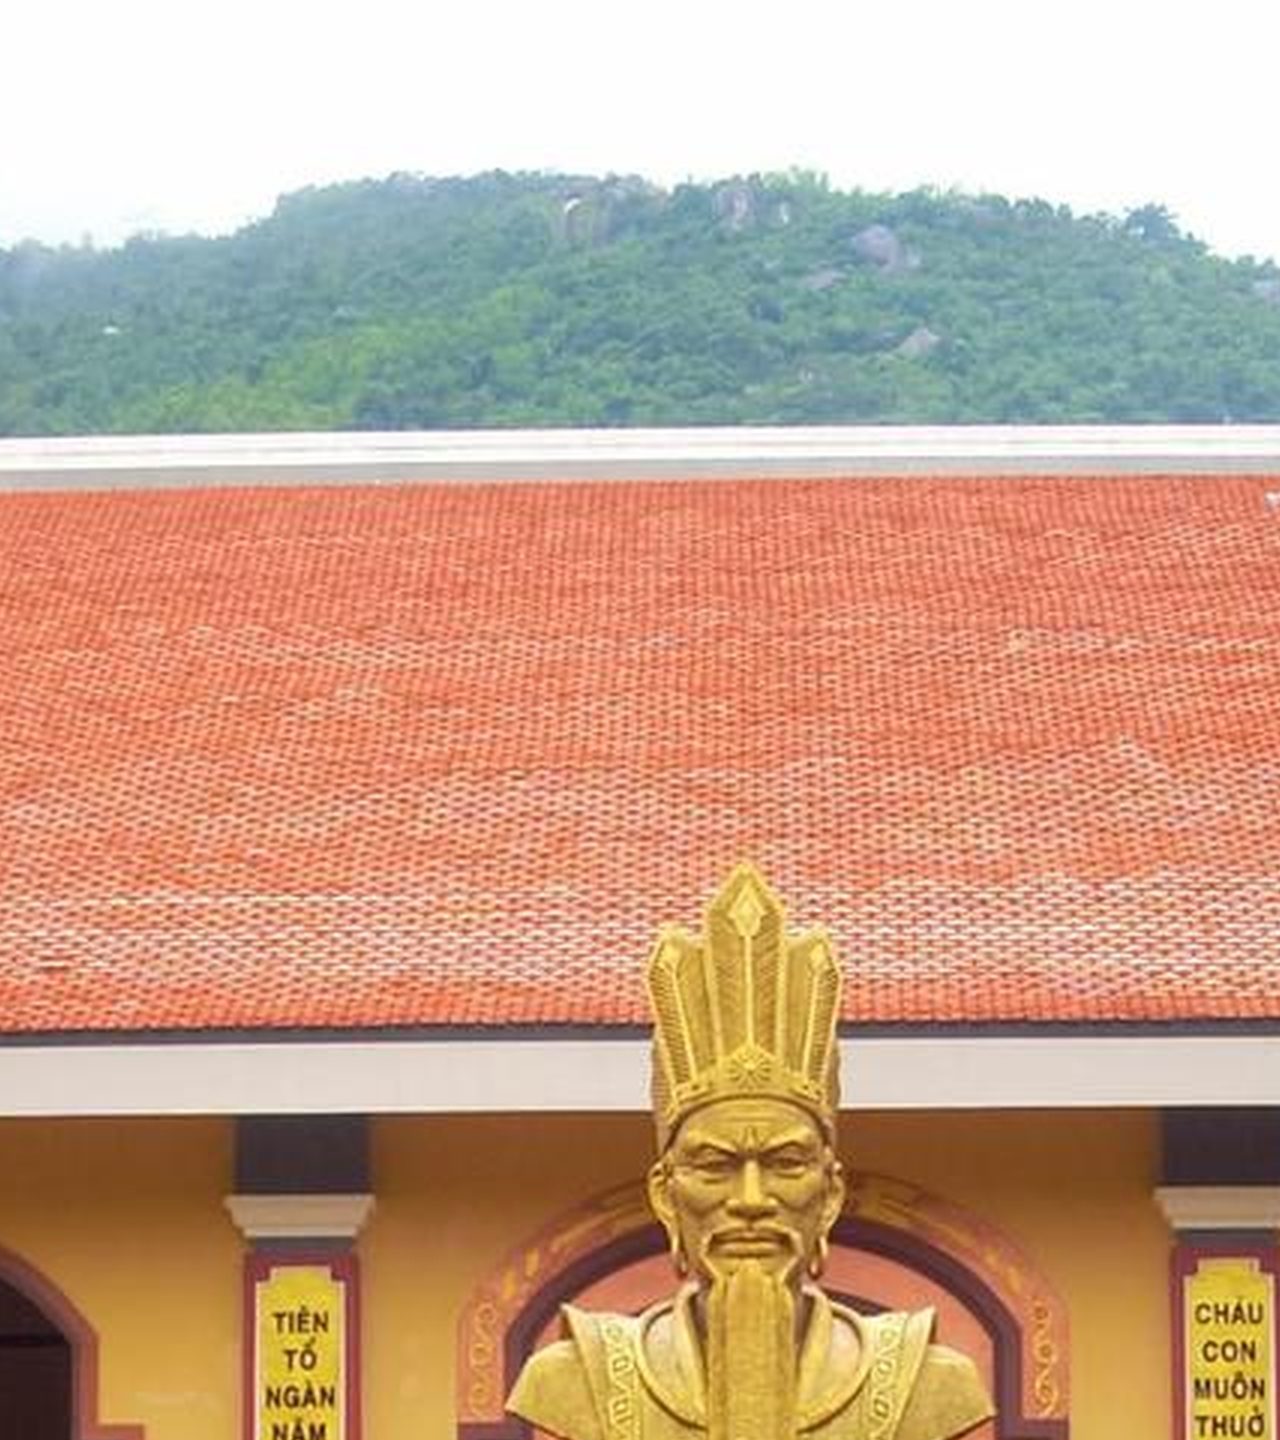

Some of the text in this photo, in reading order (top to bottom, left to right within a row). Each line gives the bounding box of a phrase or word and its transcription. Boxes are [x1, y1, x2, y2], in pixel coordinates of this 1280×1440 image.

[273, 1305, 329, 1333] TIÊN
[1195, 1296, 1264, 1324] CHÁU
[1202, 1340, 1257, 1362] CON
[265, 1380, 335, 1408] NGÀN
[1194, 1371, 1265, 1400] MUÔN
